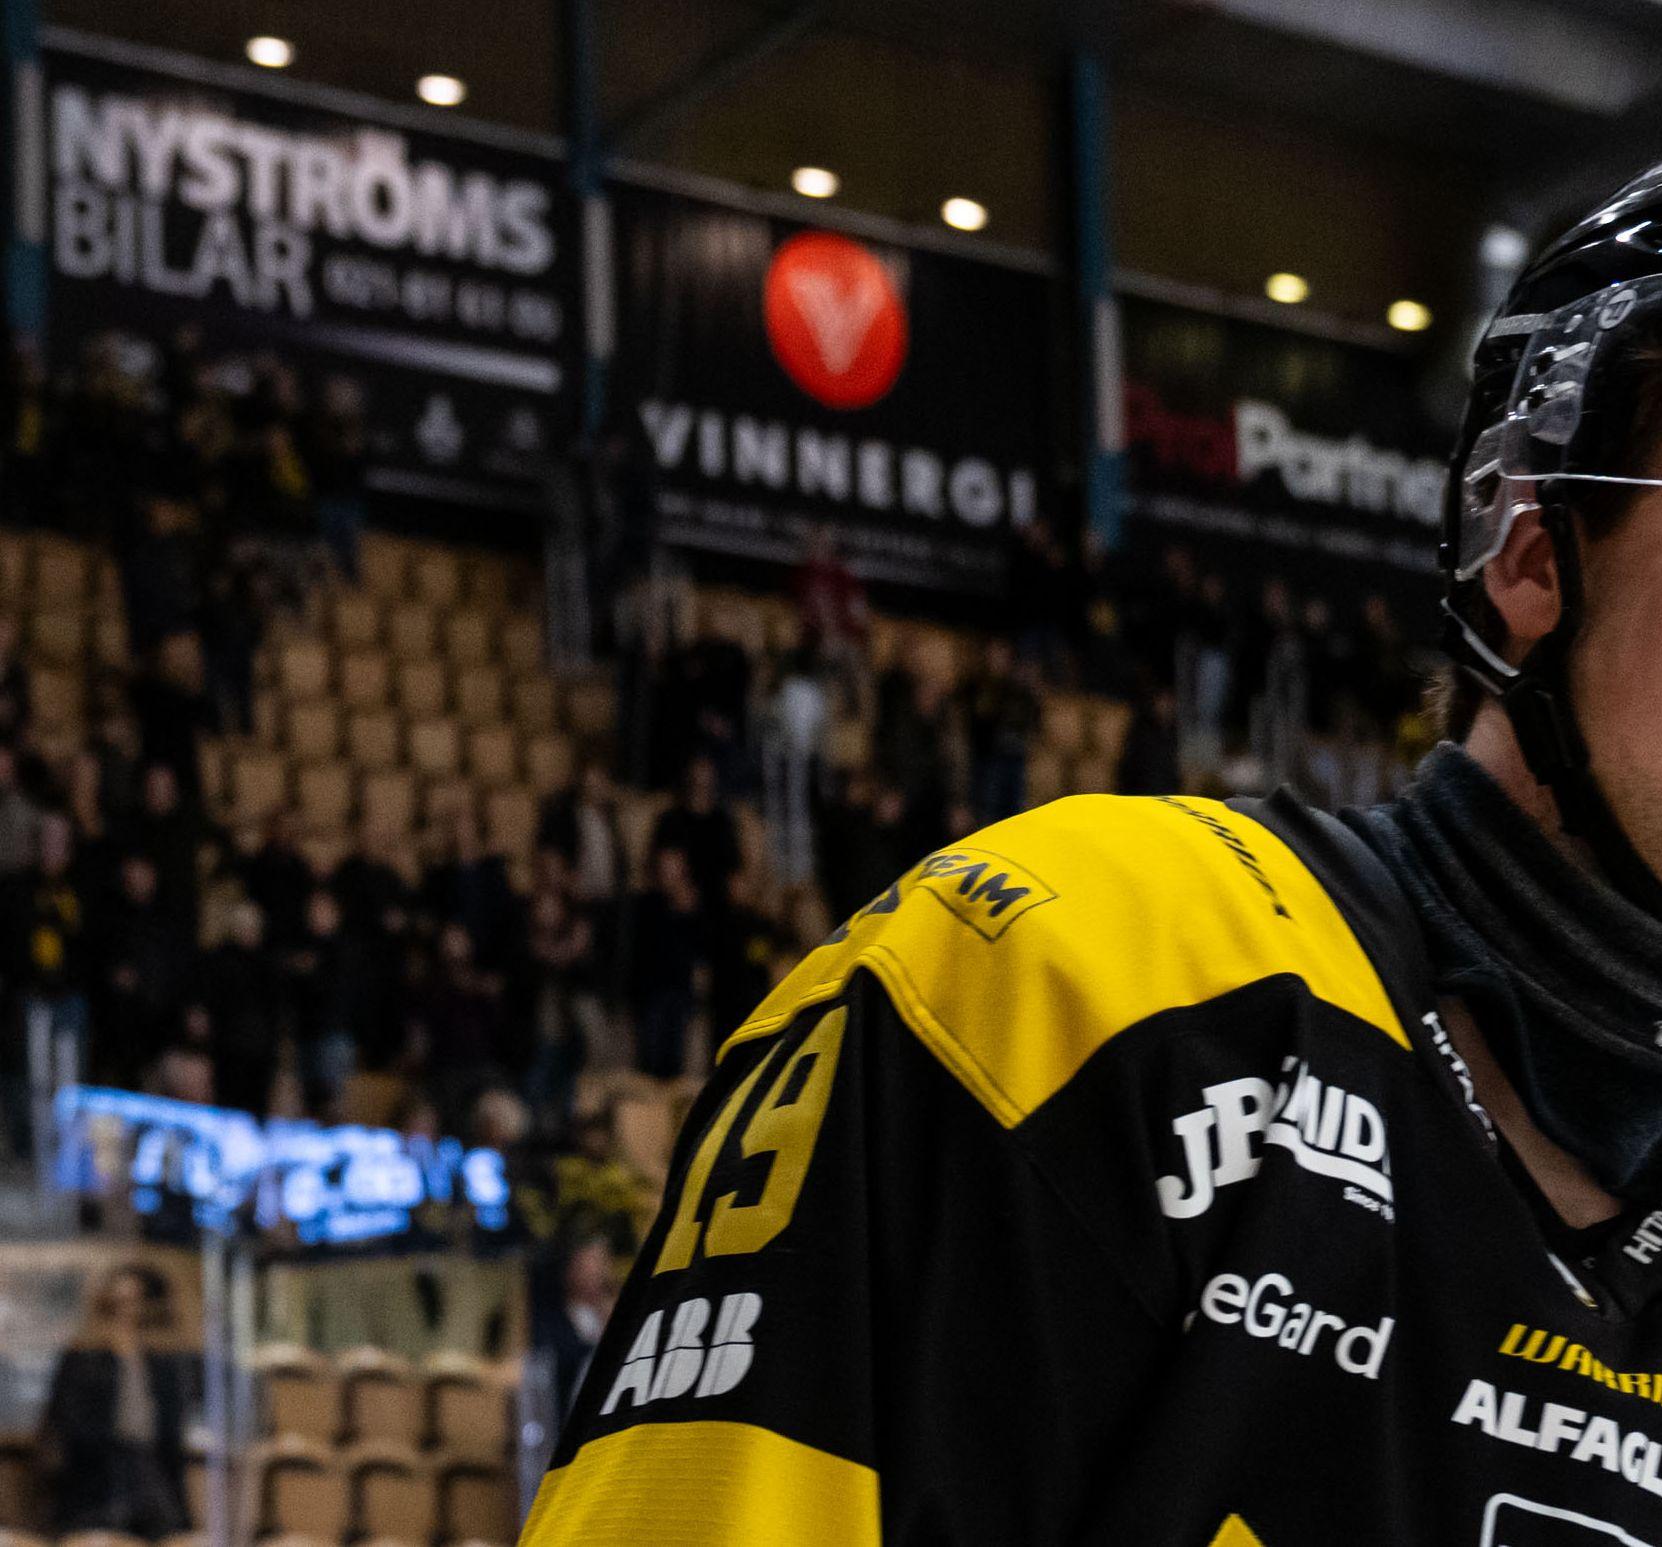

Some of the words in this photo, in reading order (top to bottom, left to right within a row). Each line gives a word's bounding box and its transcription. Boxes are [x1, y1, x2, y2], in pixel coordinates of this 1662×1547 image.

[53, 84, 557, 276] NYSTRÖMS
[54, 186, 314, 318] BILAR
[653, 1004, 848, 1277] 19
[600, 1292, 762, 1416] ABB
[1183, 1272, 1397, 1380] eGard
